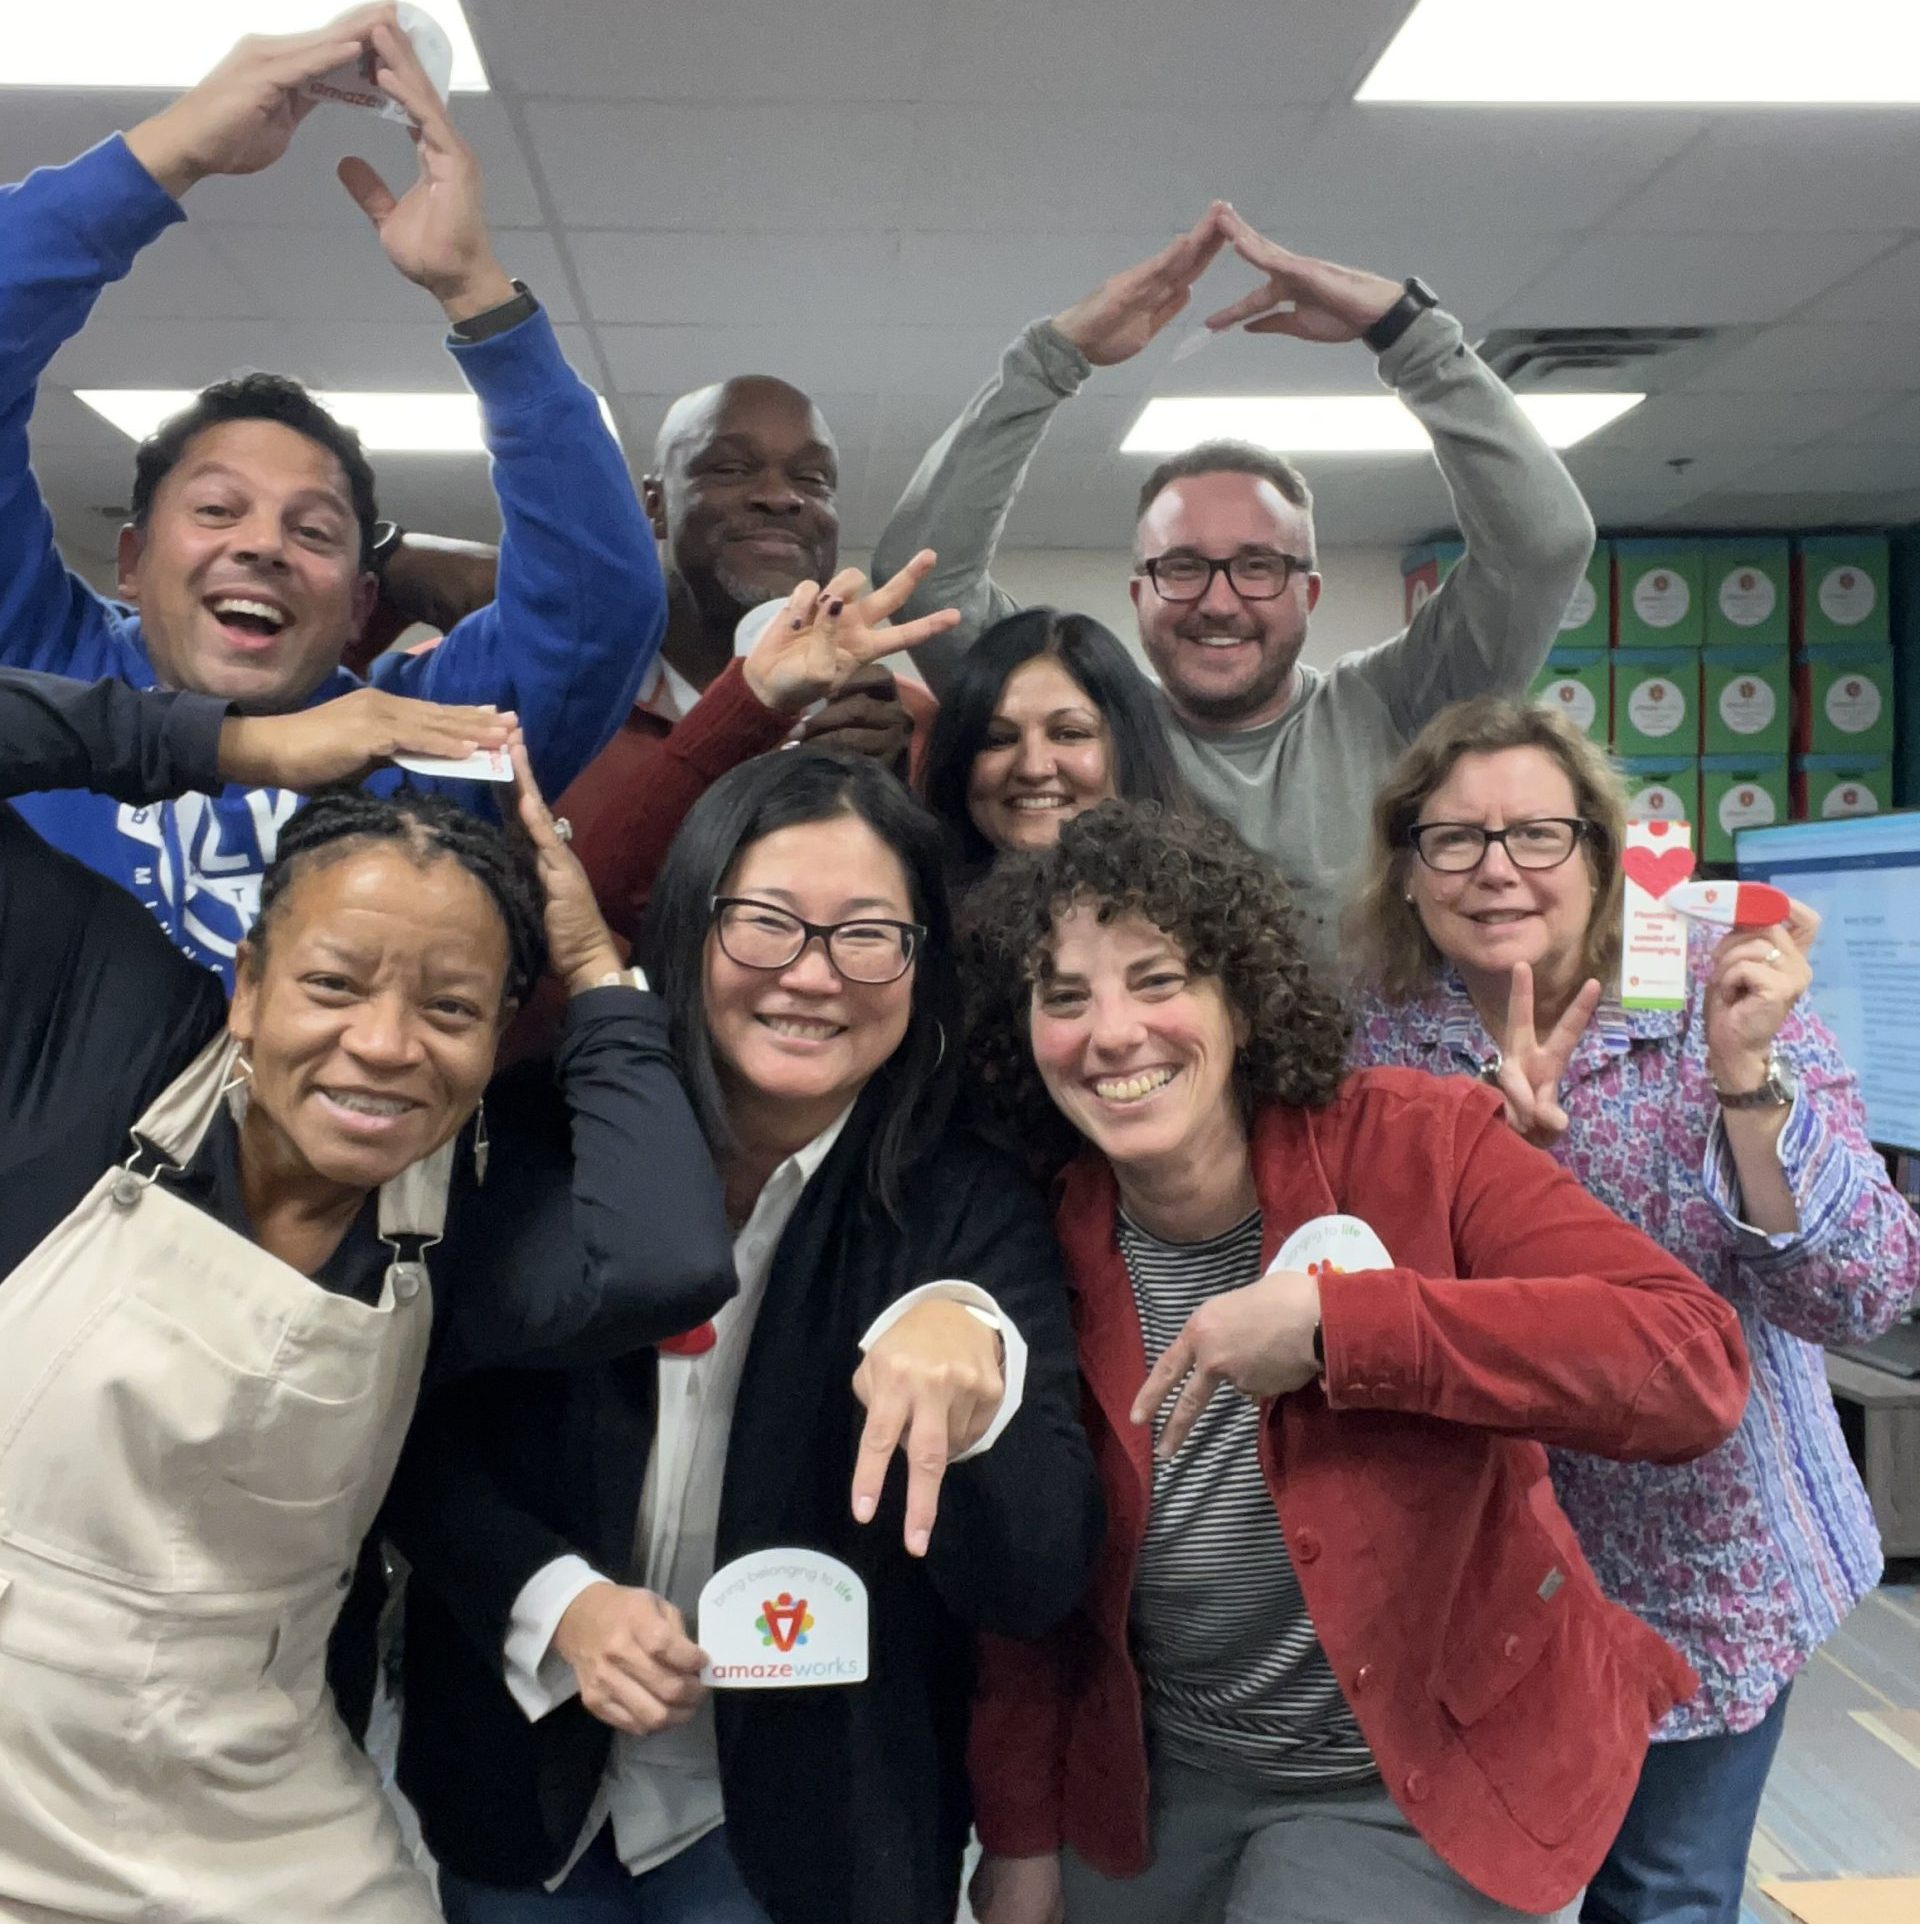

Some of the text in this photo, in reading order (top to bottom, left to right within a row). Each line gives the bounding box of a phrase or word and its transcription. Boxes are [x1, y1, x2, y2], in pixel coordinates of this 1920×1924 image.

[1341, 1222, 1361, 1238] life
[713, 1564, 853, 1608] bring belonging to life
[711, 1656, 857, 1679] amazeworks
